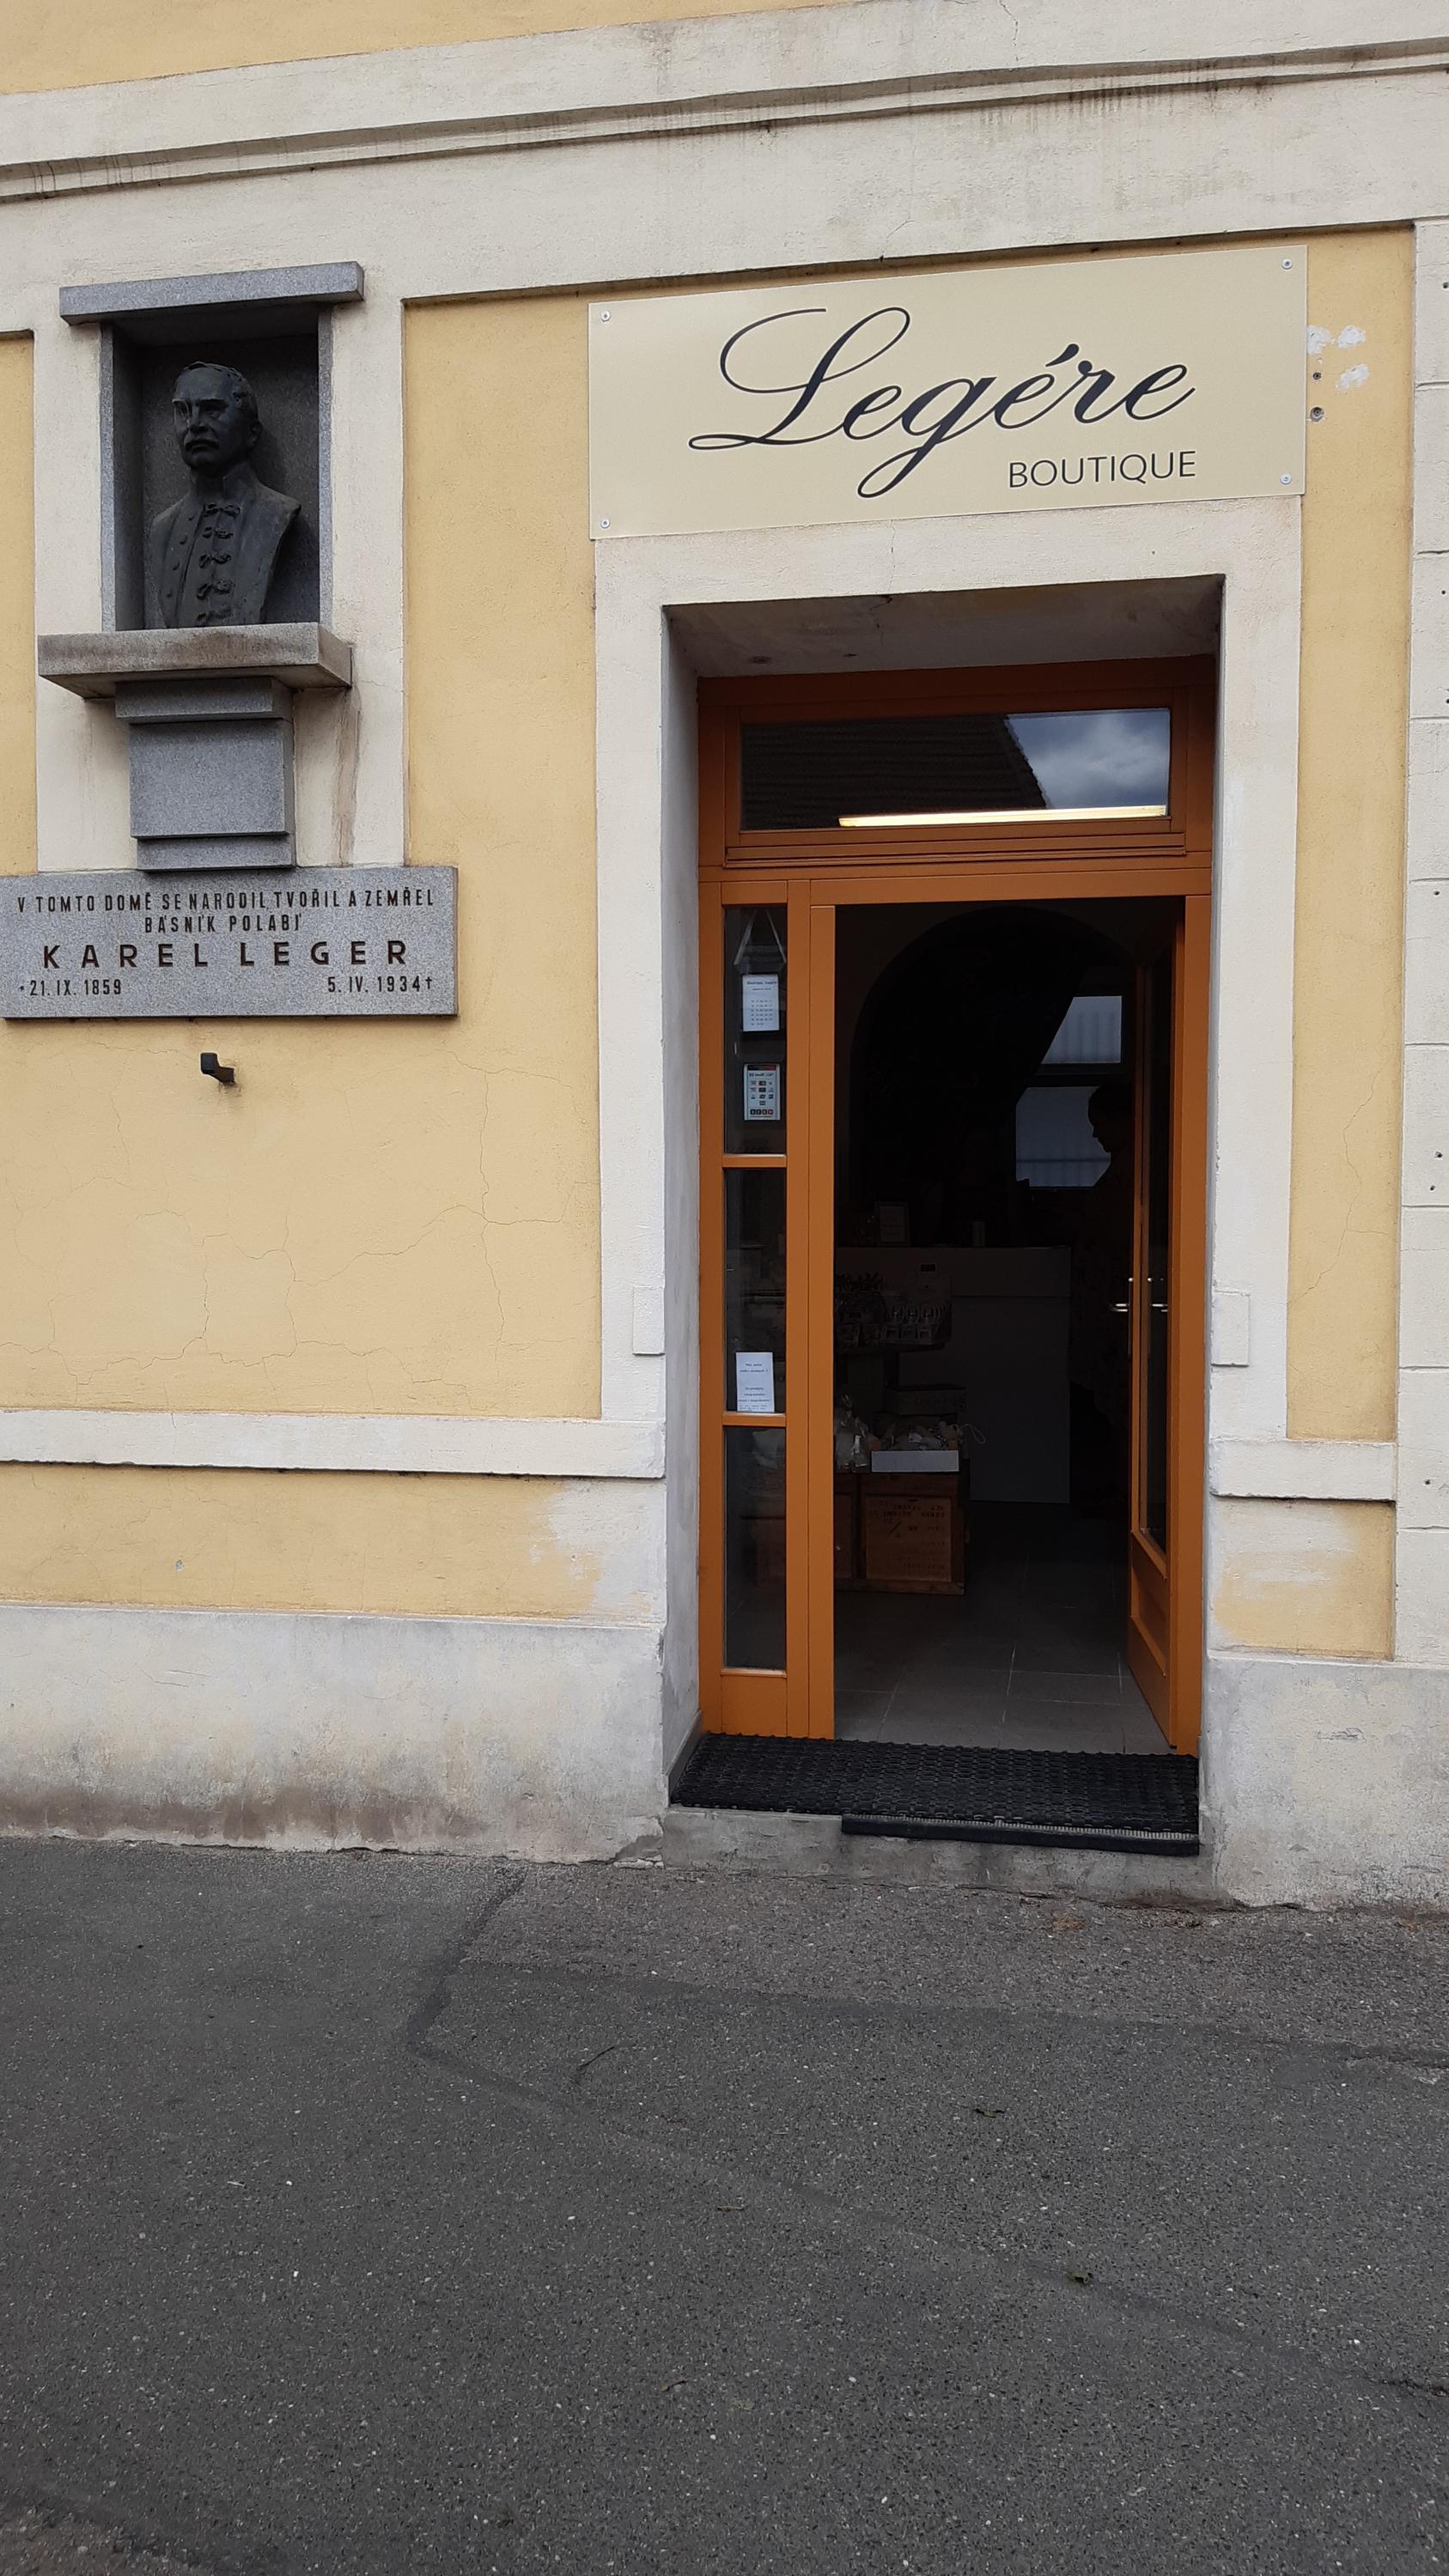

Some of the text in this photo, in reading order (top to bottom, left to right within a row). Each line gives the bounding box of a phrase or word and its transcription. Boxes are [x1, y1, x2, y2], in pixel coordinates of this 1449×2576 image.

[688, 306, 1196, 499] Legére
[1009, 450, 1196, 489] BOUTIQUE
[17, 896, 26, 913] V
[35, 895, 95, 913] TOMTO
[105, 892, 152, 912] DOMĚ
[161, 893, 181, 910] SE
[274, 889, 340, 908] TVOŘIL
[348, 890, 357, 908] A
[364, 887, 434, 907] ZEMŘEL
[144, 914, 216, 933] BÁSNÍK
[43, 939, 406, 969] KAREL LEGER
[84, 978, 122, 996] 1859
[327, 976, 342, 993] 5.
